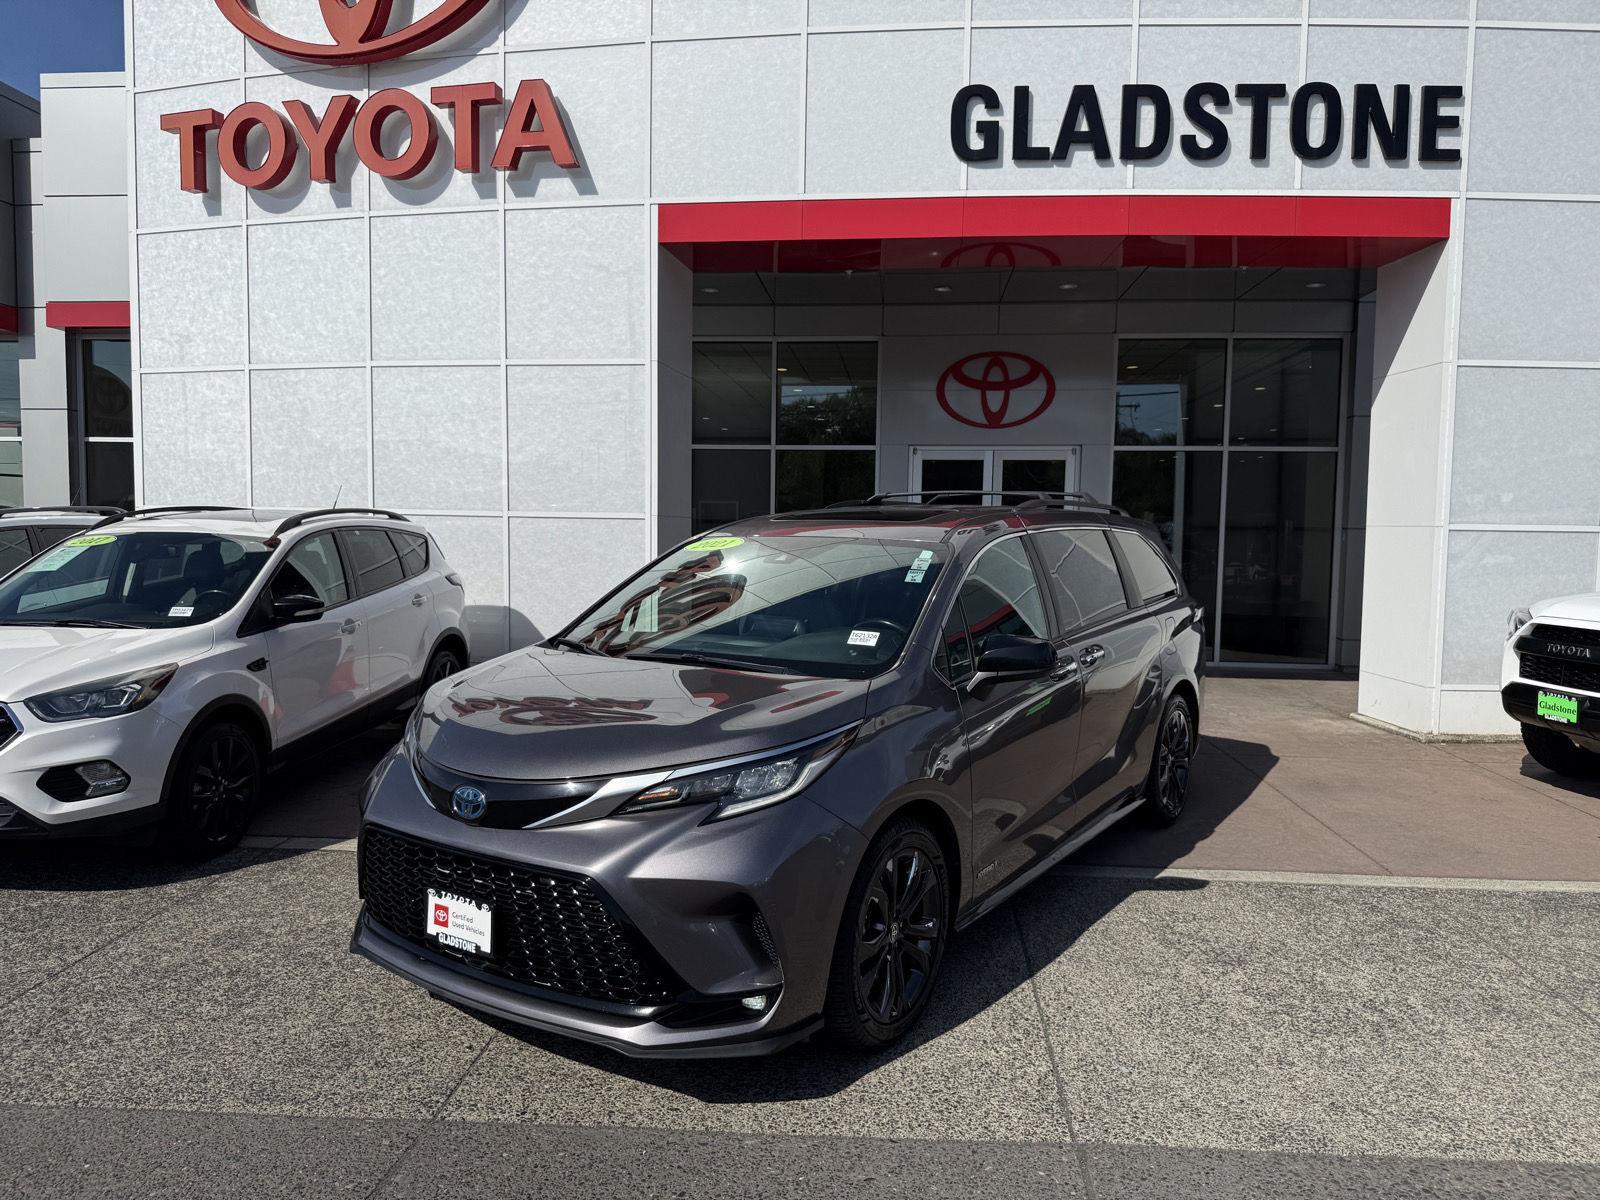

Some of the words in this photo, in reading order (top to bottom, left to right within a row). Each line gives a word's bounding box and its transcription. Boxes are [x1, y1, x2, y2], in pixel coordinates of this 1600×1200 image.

[950, 82, 1463, 162] GLADSTONE
[160, 79, 580, 193] TOYOTA
[1547, 643, 1590, 658] TOYOTA
[1539, 700, 1577, 715] Gladstone
[441, 891, 476, 906] TOYOTA
[452, 911, 474, 923] Certified
[452, 920, 465, 930] Used
[465, 924, 485, 937] Vehicles
[439, 932, 476, 953] GLADSTONE
